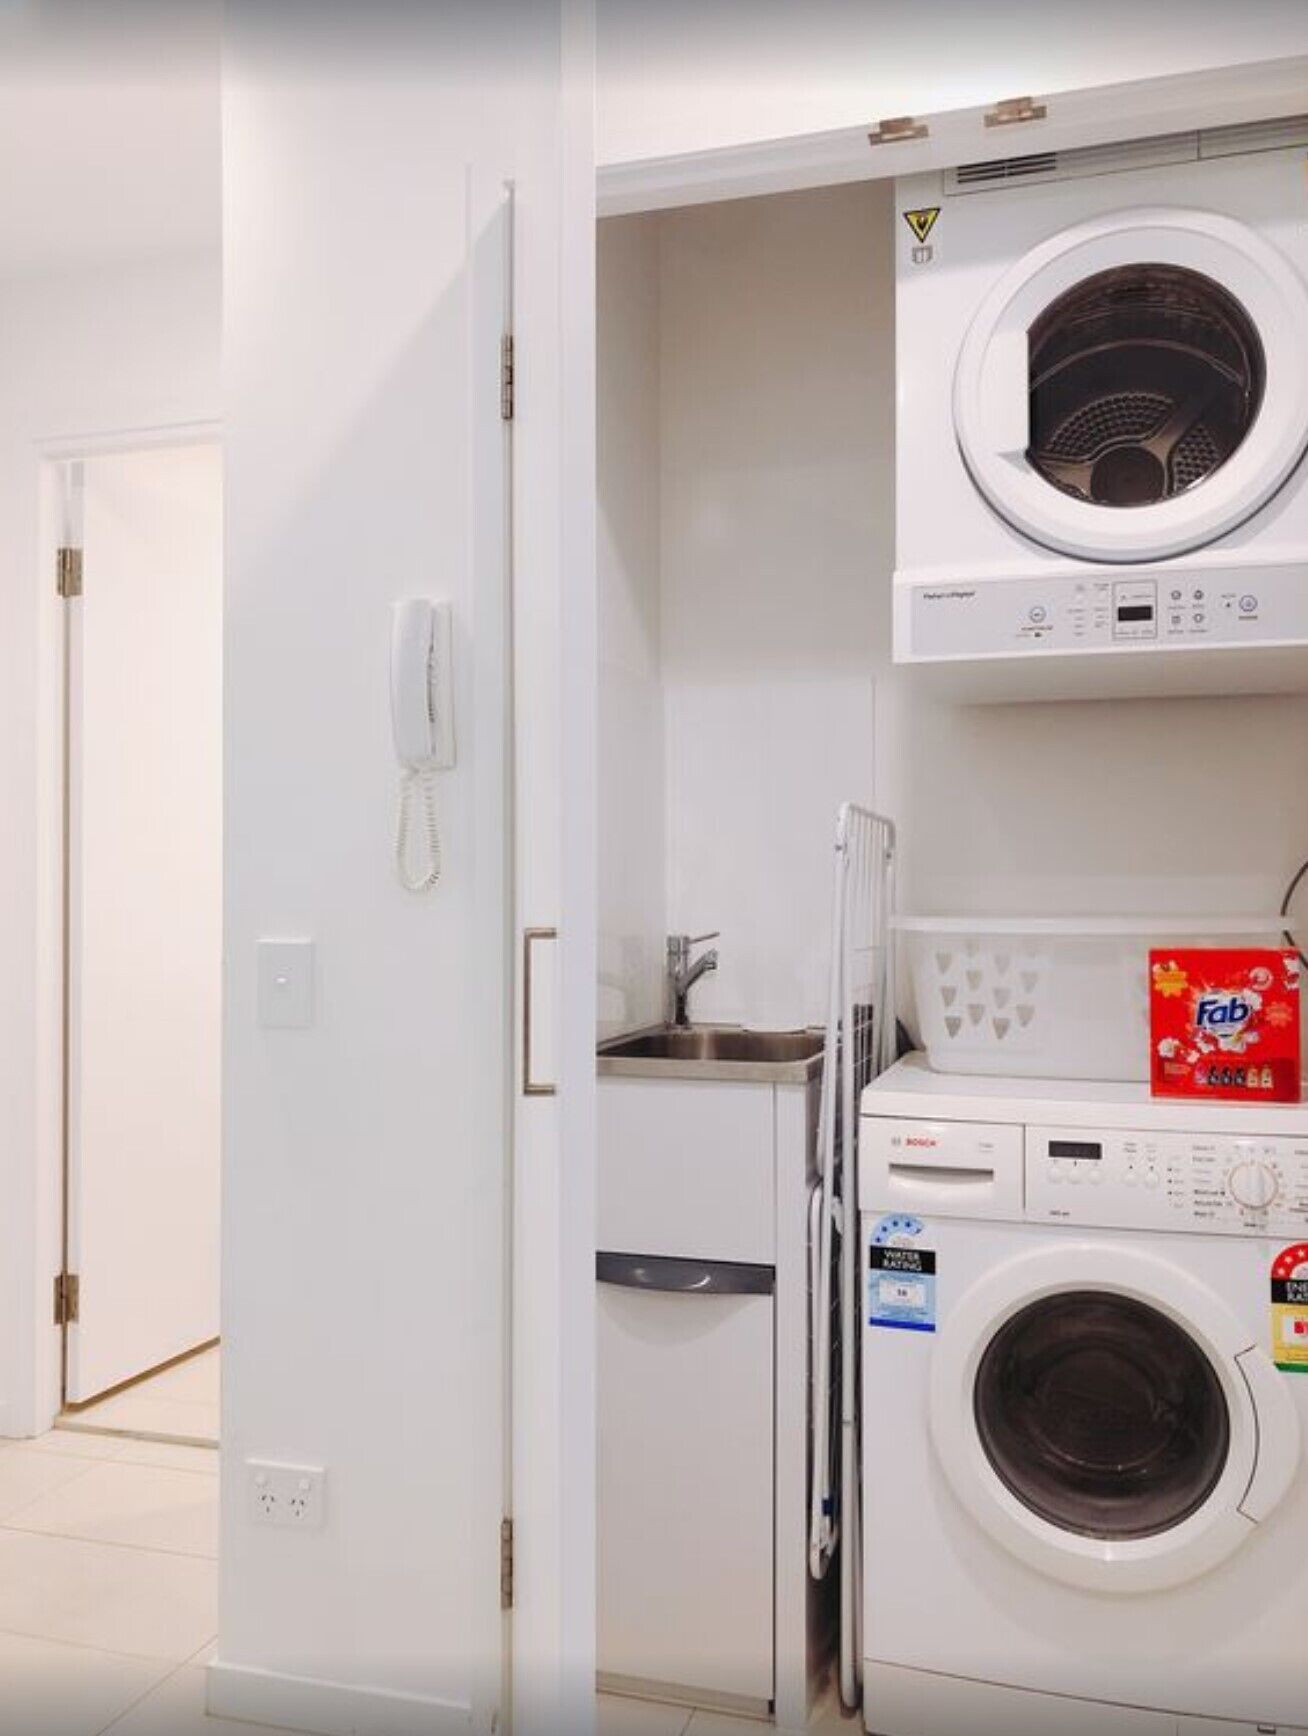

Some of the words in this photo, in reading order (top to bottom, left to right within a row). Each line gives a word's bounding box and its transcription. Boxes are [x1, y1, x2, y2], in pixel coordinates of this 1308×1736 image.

[1197, 997, 1249, 1025] Fab
[906, 1138, 937, 1147] BOSCH
[883, 1250, 921, 1260] WATER
[883, 1260, 922, 1271] RATING
